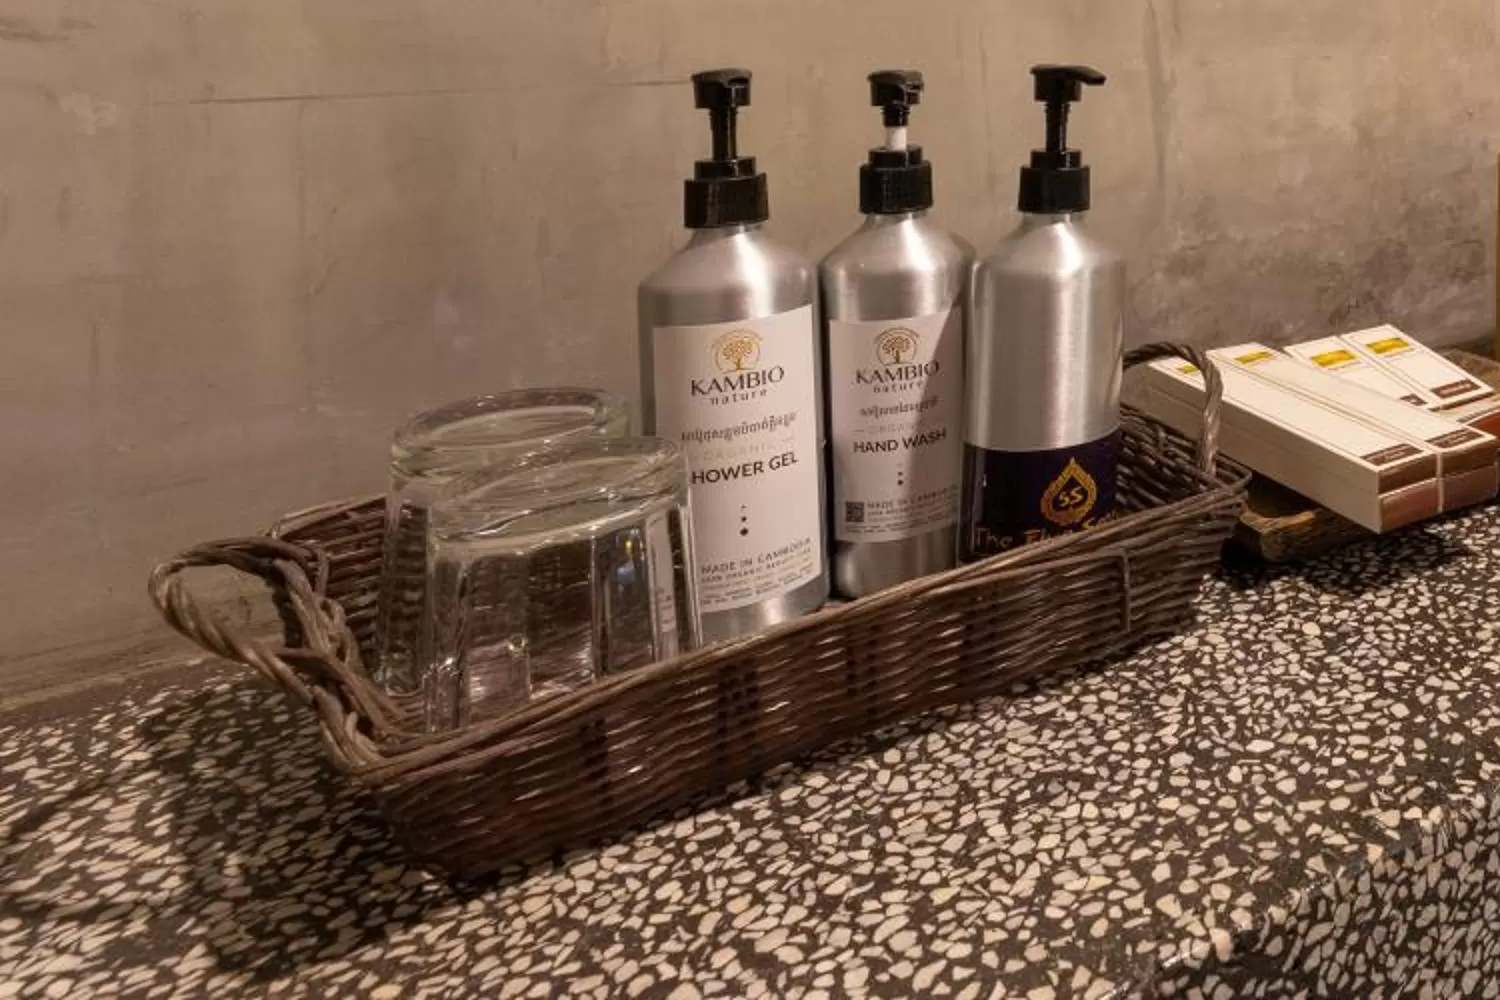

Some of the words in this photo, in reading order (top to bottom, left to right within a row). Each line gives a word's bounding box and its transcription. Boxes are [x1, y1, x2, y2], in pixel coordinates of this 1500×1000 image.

[690, 365, 785, 397] KAMBIO
[855, 360, 940, 385] KAMBIO
[710, 389, 767, 406] nature
[873, 382, 924, 394] nature
[853, 439, 899, 453] HAND
[902, 428, 947, 450] WASH
[691, 461, 765, 485] HOWER
[768, 451, 799, 471] GEL
[701, 561, 737, 575] MADE
